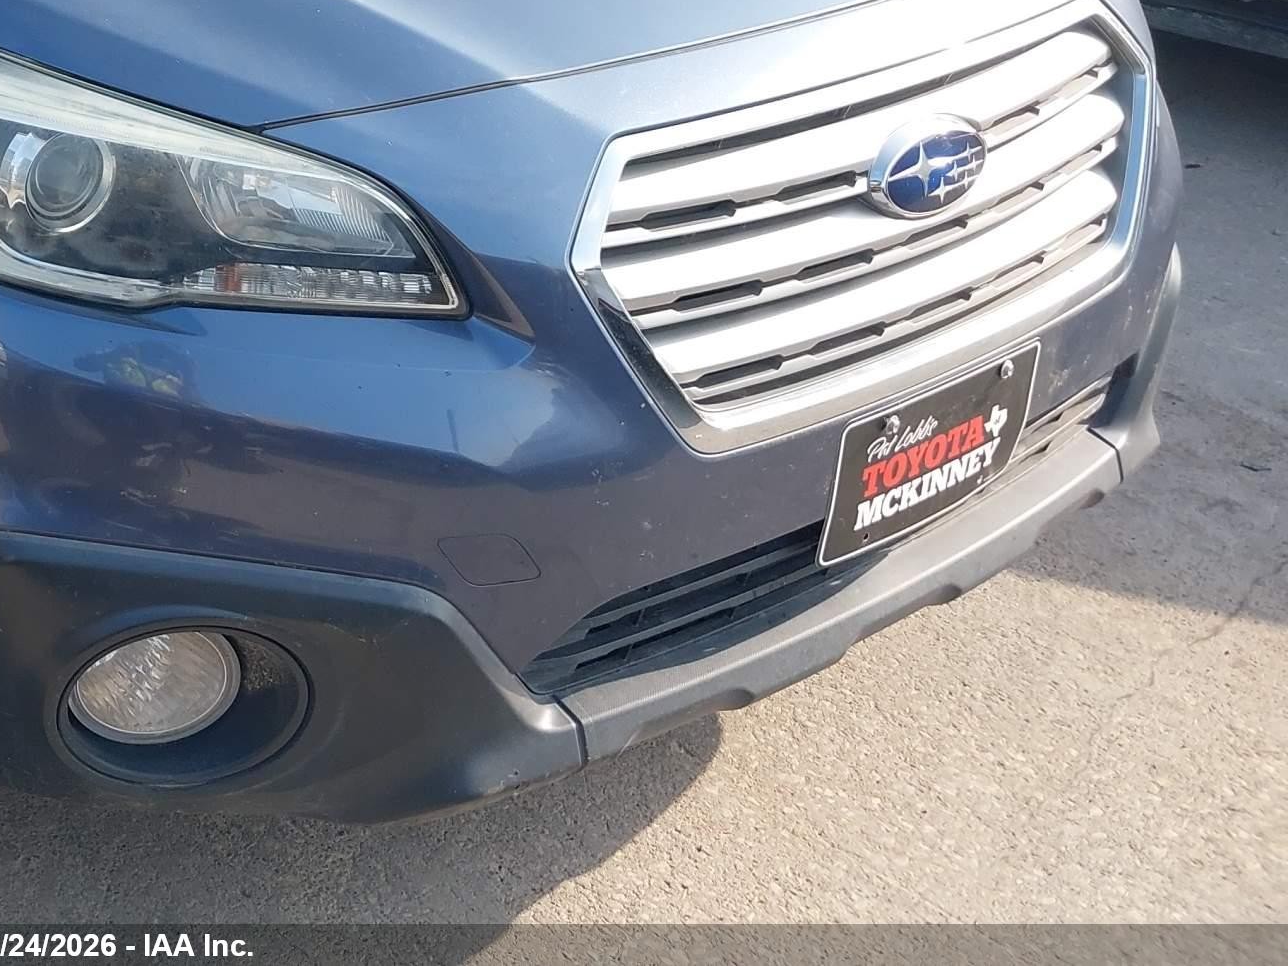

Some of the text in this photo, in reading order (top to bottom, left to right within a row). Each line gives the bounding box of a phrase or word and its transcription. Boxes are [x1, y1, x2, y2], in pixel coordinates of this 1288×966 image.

[853, 437, 1001, 531] MCKINNEY
[862, 415, 985, 497] TOYOTA
[867, 435, 896, 463] Pat
